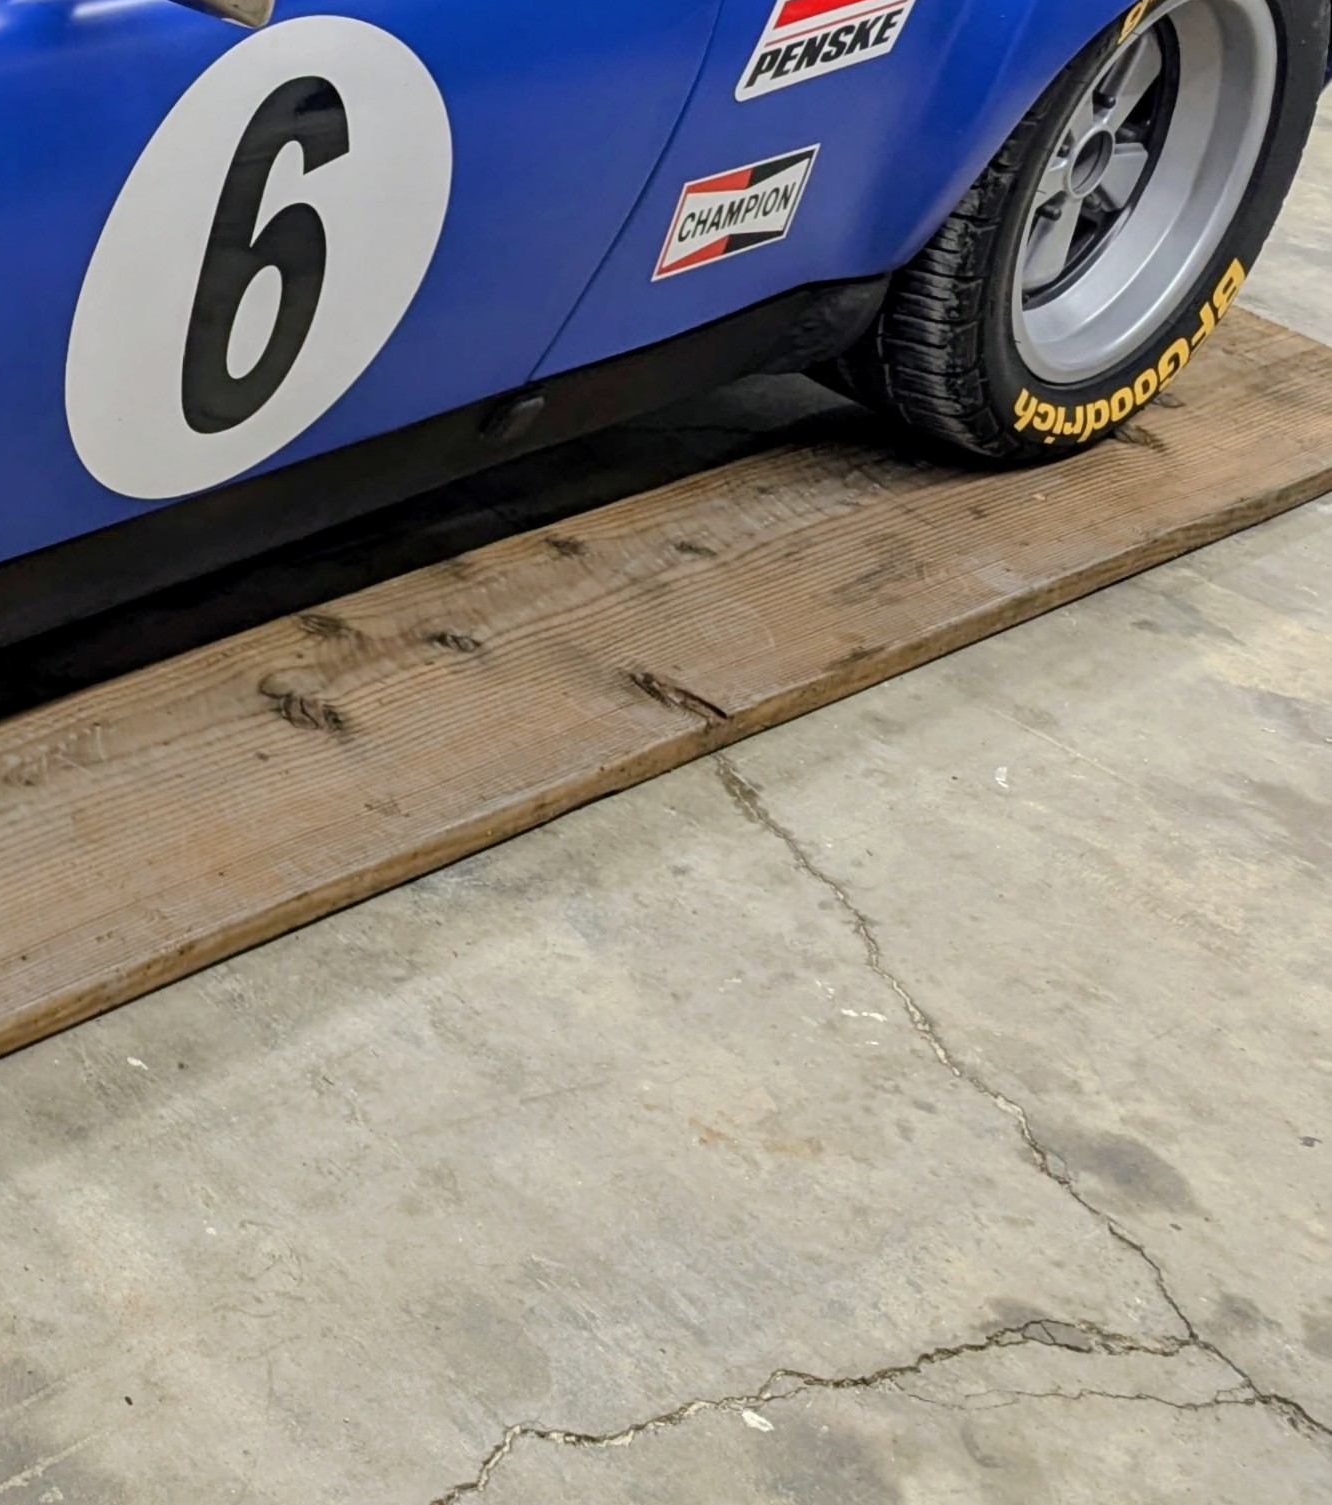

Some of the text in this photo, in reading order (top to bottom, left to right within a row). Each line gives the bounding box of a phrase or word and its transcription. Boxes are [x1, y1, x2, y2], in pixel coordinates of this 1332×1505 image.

[744, 7, 905, 89] PENSKE
[181, 75, 351, 435] 6
[677, 181, 797, 243] CHAMPION
[1013, 257, 1247, 446] BFGoodrich
